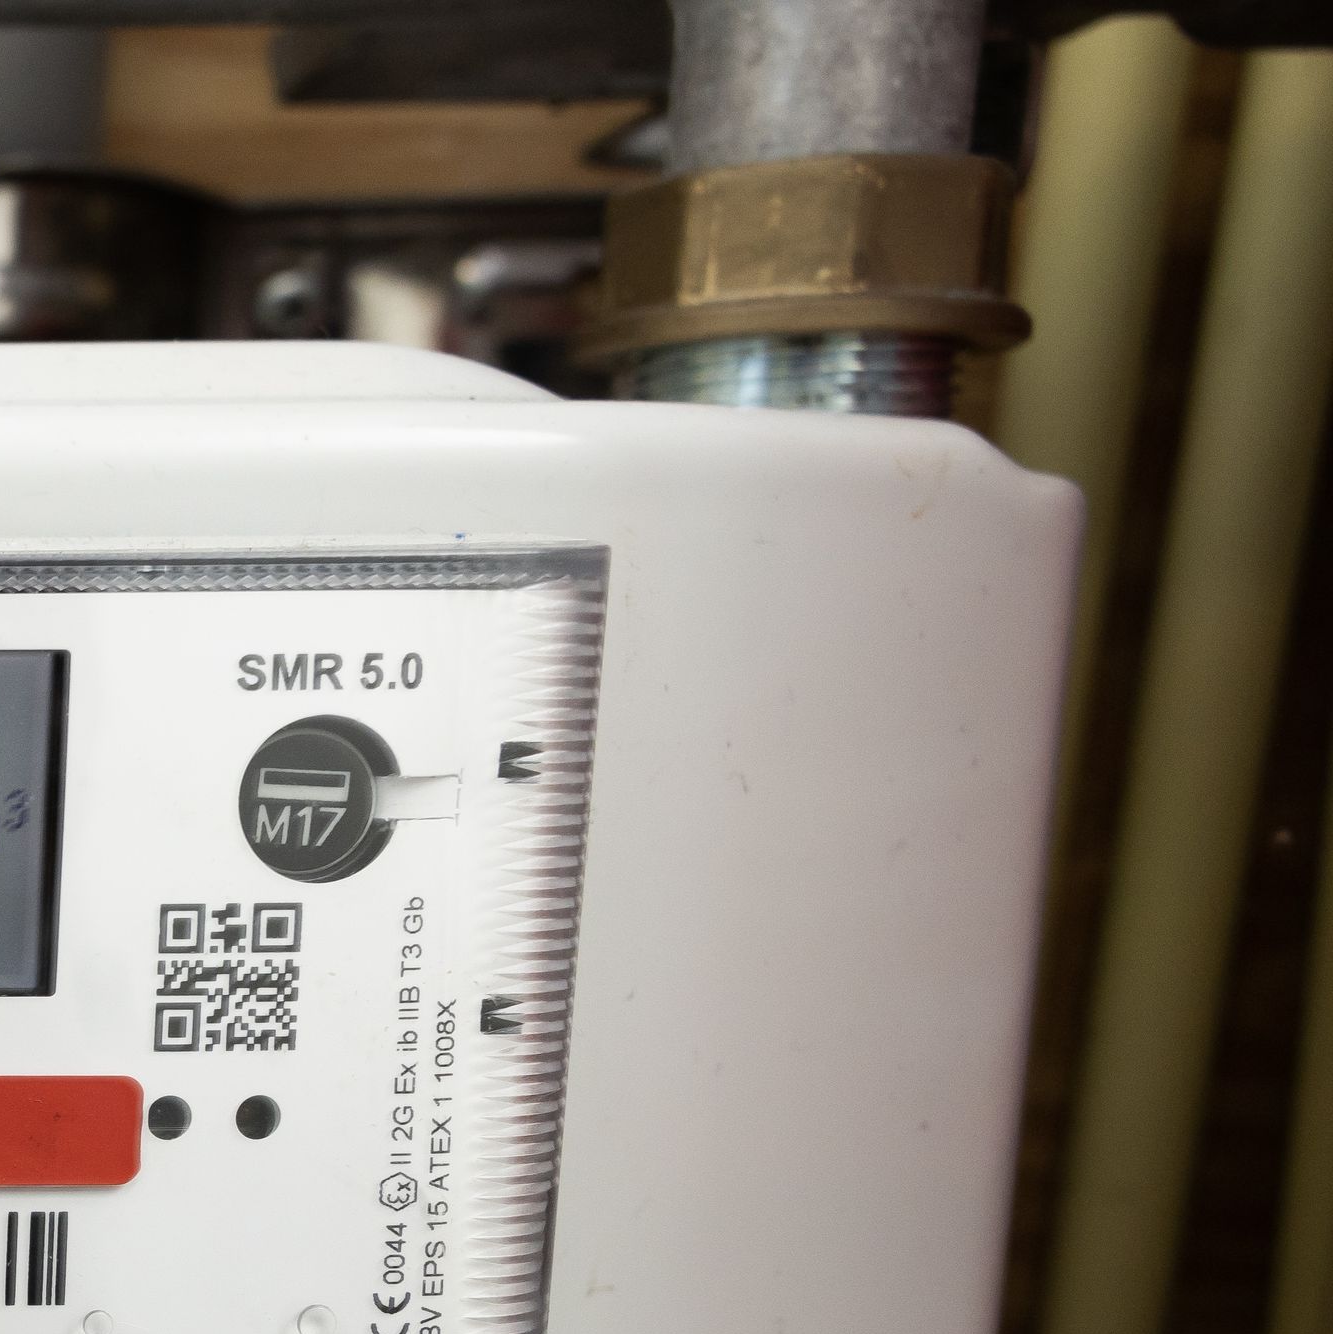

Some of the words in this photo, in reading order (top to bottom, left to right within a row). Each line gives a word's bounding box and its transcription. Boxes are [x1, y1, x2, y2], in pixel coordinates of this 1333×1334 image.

[236, 653, 343, 692] SMR
[360, 652, 423, 690] 5.0
[254, 804, 348, 847] M17
[402, 896, 425, 935] Gb
[400, 943, 423, 978] T3
[397, 985, 420, 1020] IIB
[396, 1030, 418, 1052] ib
[434, 999, 457, 1083] 1008X
[393, 1063, 417, 1095] Ex
[391, 1105, 414, 1142] 2G
[428, 1116, 452, 1192] ATEX
[426, 1200, 449, 1231] 15
[382, 1222, 408, 1285] 0044
[421, 1240, 446, 1297] EPS
